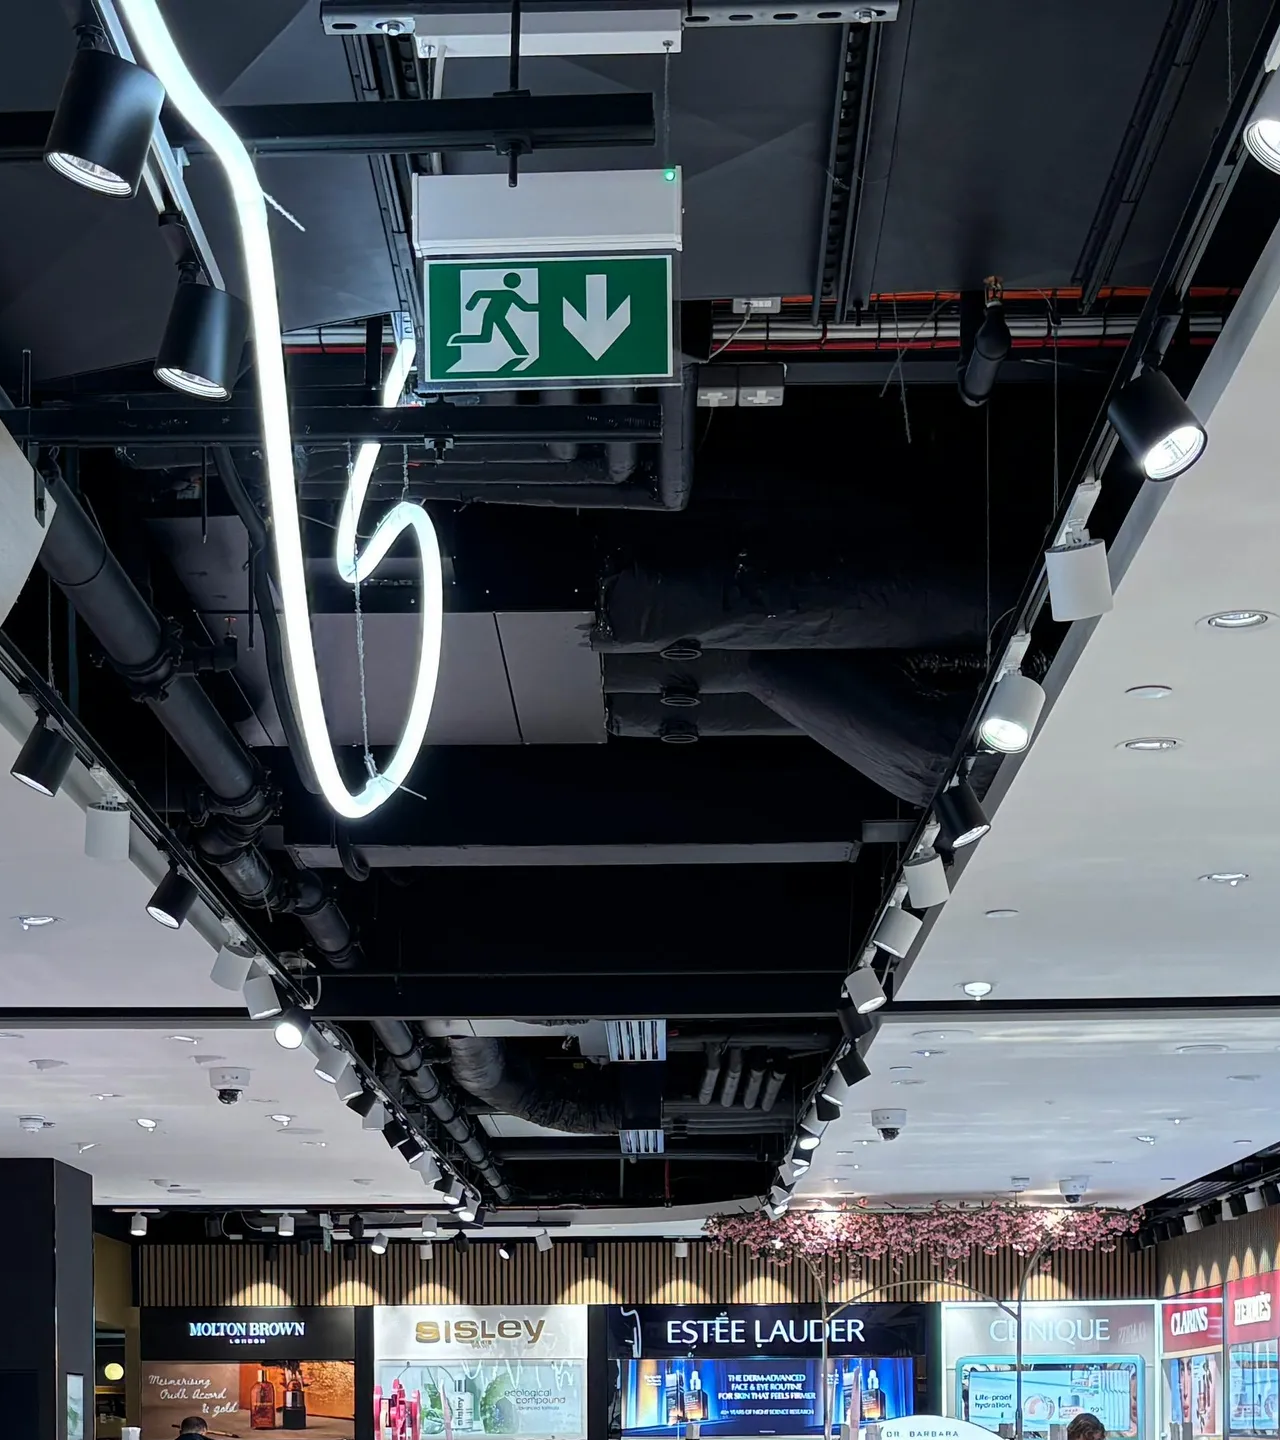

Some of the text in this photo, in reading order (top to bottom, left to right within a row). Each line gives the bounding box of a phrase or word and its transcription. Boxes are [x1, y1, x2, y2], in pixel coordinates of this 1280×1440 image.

[1171, 1306, 1209, 1336] CLARINS
[189, 1322, 305, 1337] MOLTON BROWN
[755, 1319, 866, 1344] LAUDER
[989, 1318, 1111, 1345] CLINIQUE
[727, 1374, 806, 1382] THE DERM-ADVANCED
[731, 1383, 748, 1391] FACE
[504, 1388, 552, 1399] ecological
[718, 1392, 816, 1400] FOR SKIN THAT FEELS FIRMER
[974, 1393, 1012, 1402] Life-proof
[515, 1396, 566, 1405] compound
[213, 1401, 239, 1417] gold
[909, 1430, 959, 1438] BARBARA
